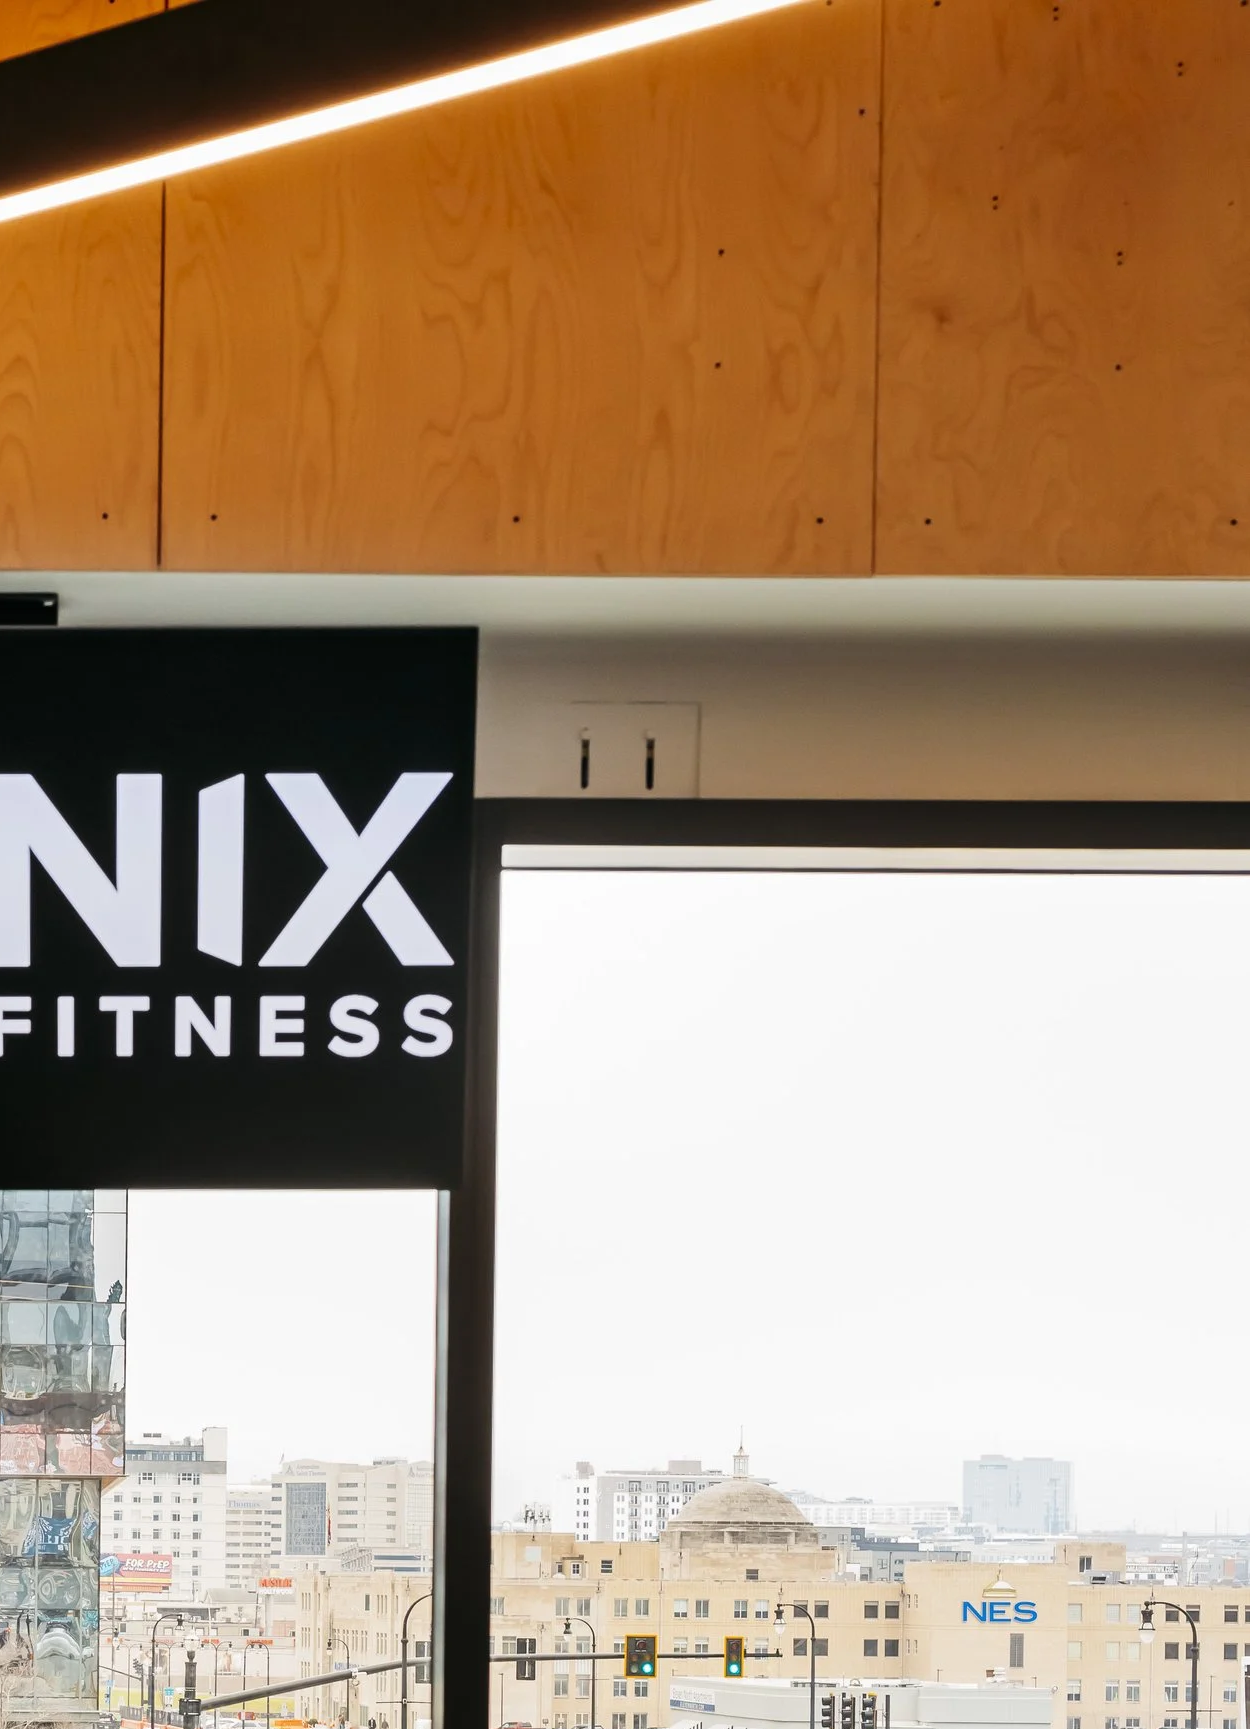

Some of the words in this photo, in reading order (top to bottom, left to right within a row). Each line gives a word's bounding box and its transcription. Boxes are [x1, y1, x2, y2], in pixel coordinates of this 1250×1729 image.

[125, 1558, 144, 1568] FOR
[147, 1560, 169, 1569] PrEP
[962, 1601, 1038, 1623] NES
